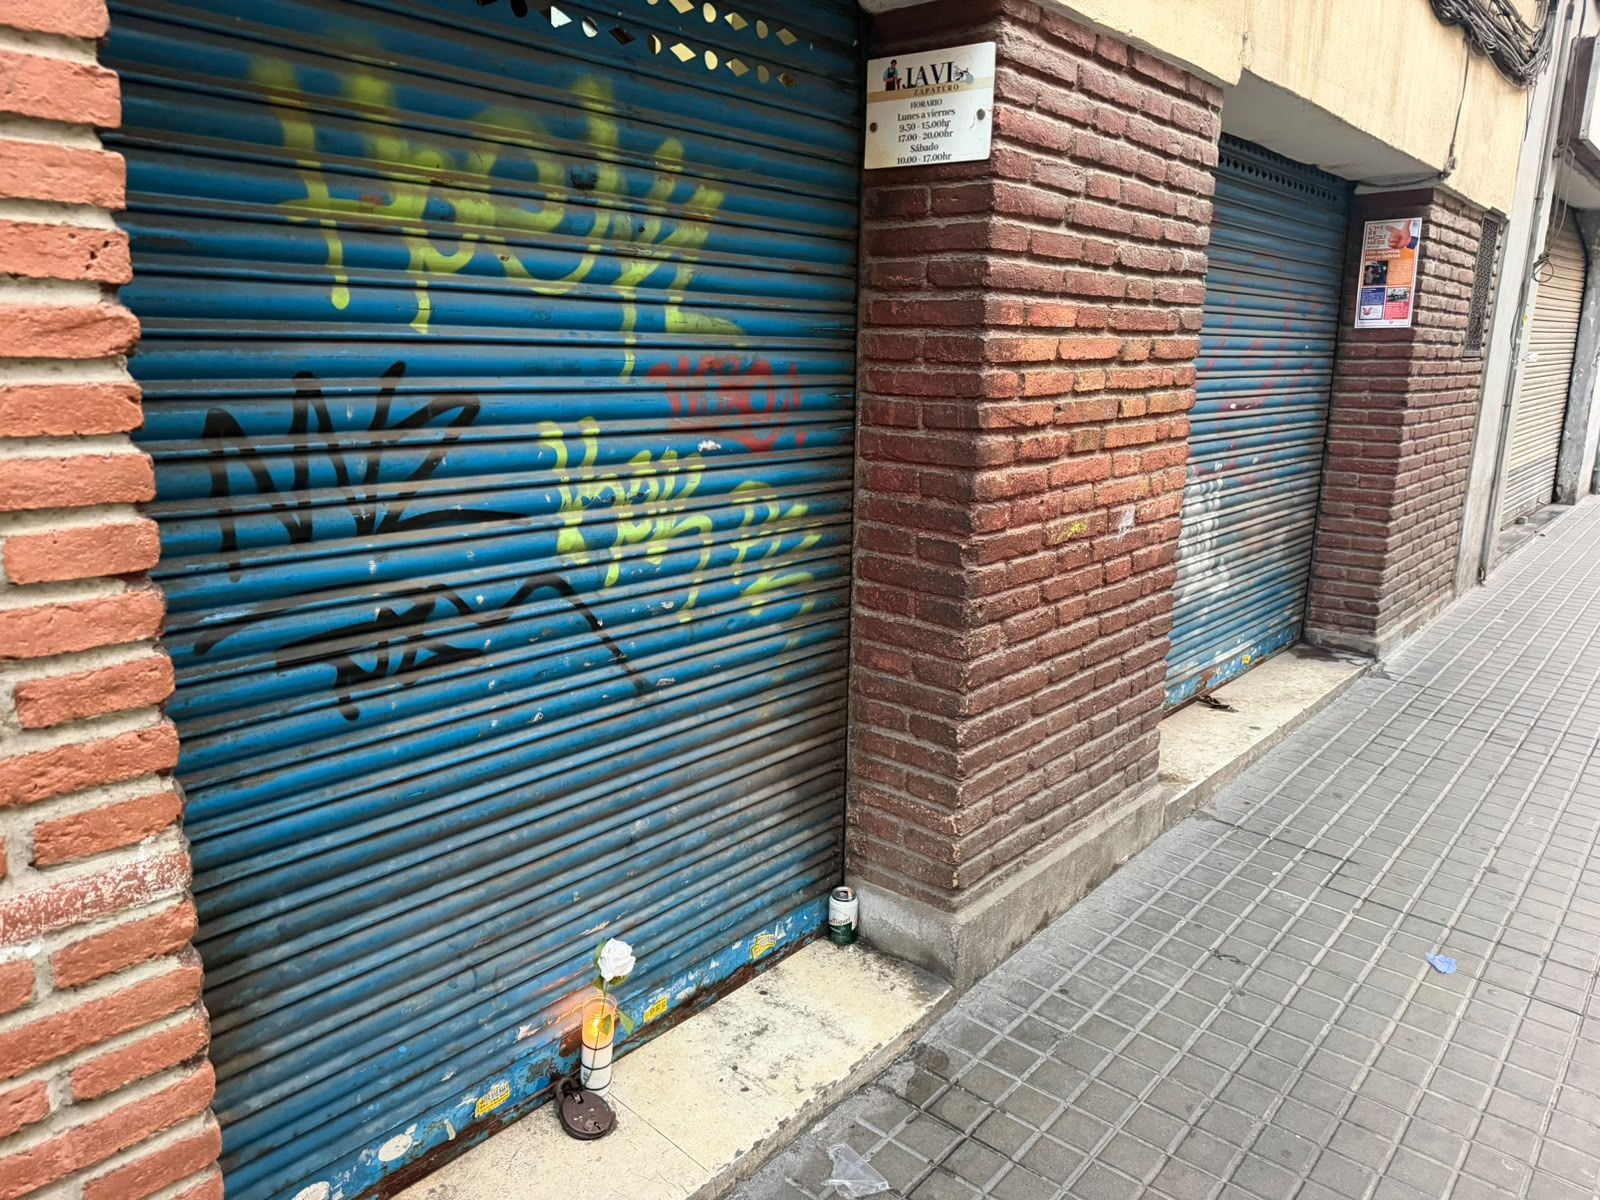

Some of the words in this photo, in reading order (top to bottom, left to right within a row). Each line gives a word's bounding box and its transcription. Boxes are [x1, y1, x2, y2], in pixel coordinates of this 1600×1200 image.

[902, 61, 953, 88] JAVI
[914, 84, 960, 97] ZAPATERO
[910, 99, 942, 109] HORARIO
[897, 113, 920, 121] Lunes
[927, 109, 956, 118] viernes
[898, 134, 918, 143] 17.00
[922, 130, 954, 140] 20.00hr
[910, 142, 939, 153] Sábado
[897, 156, 917, 164] 10.00
[923, 151, 952, 163] 17.00hr
